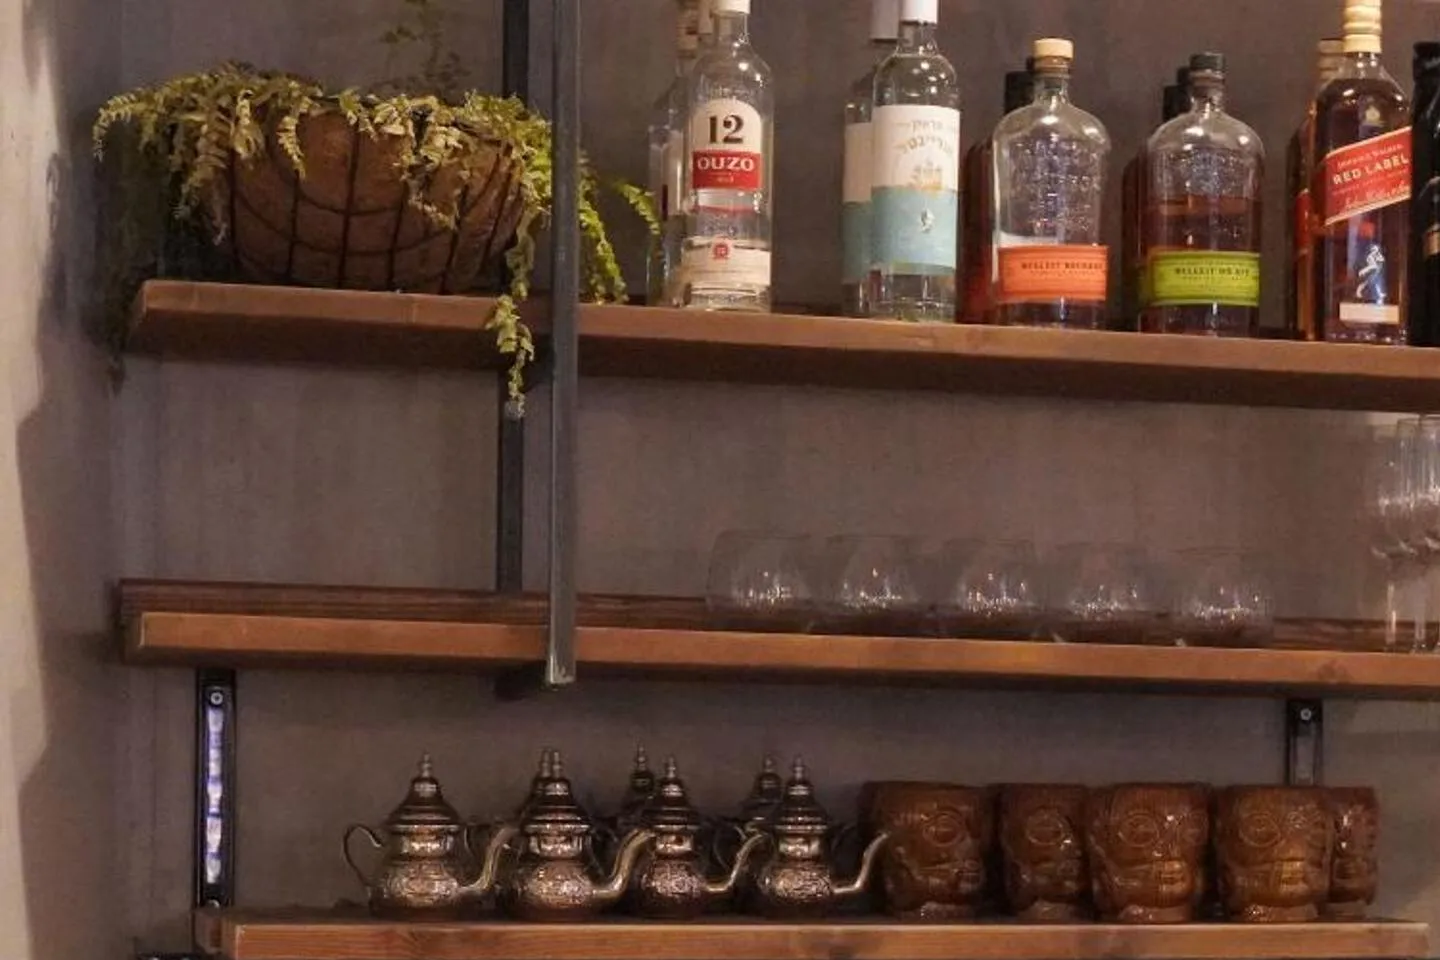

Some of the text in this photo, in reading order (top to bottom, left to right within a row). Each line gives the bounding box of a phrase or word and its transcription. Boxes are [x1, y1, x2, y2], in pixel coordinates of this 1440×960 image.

[708, 114, 744, 144] 12
[697, 156, 755, 172] OUZO
[1332, 152, 1410, 185] RED LABEL
